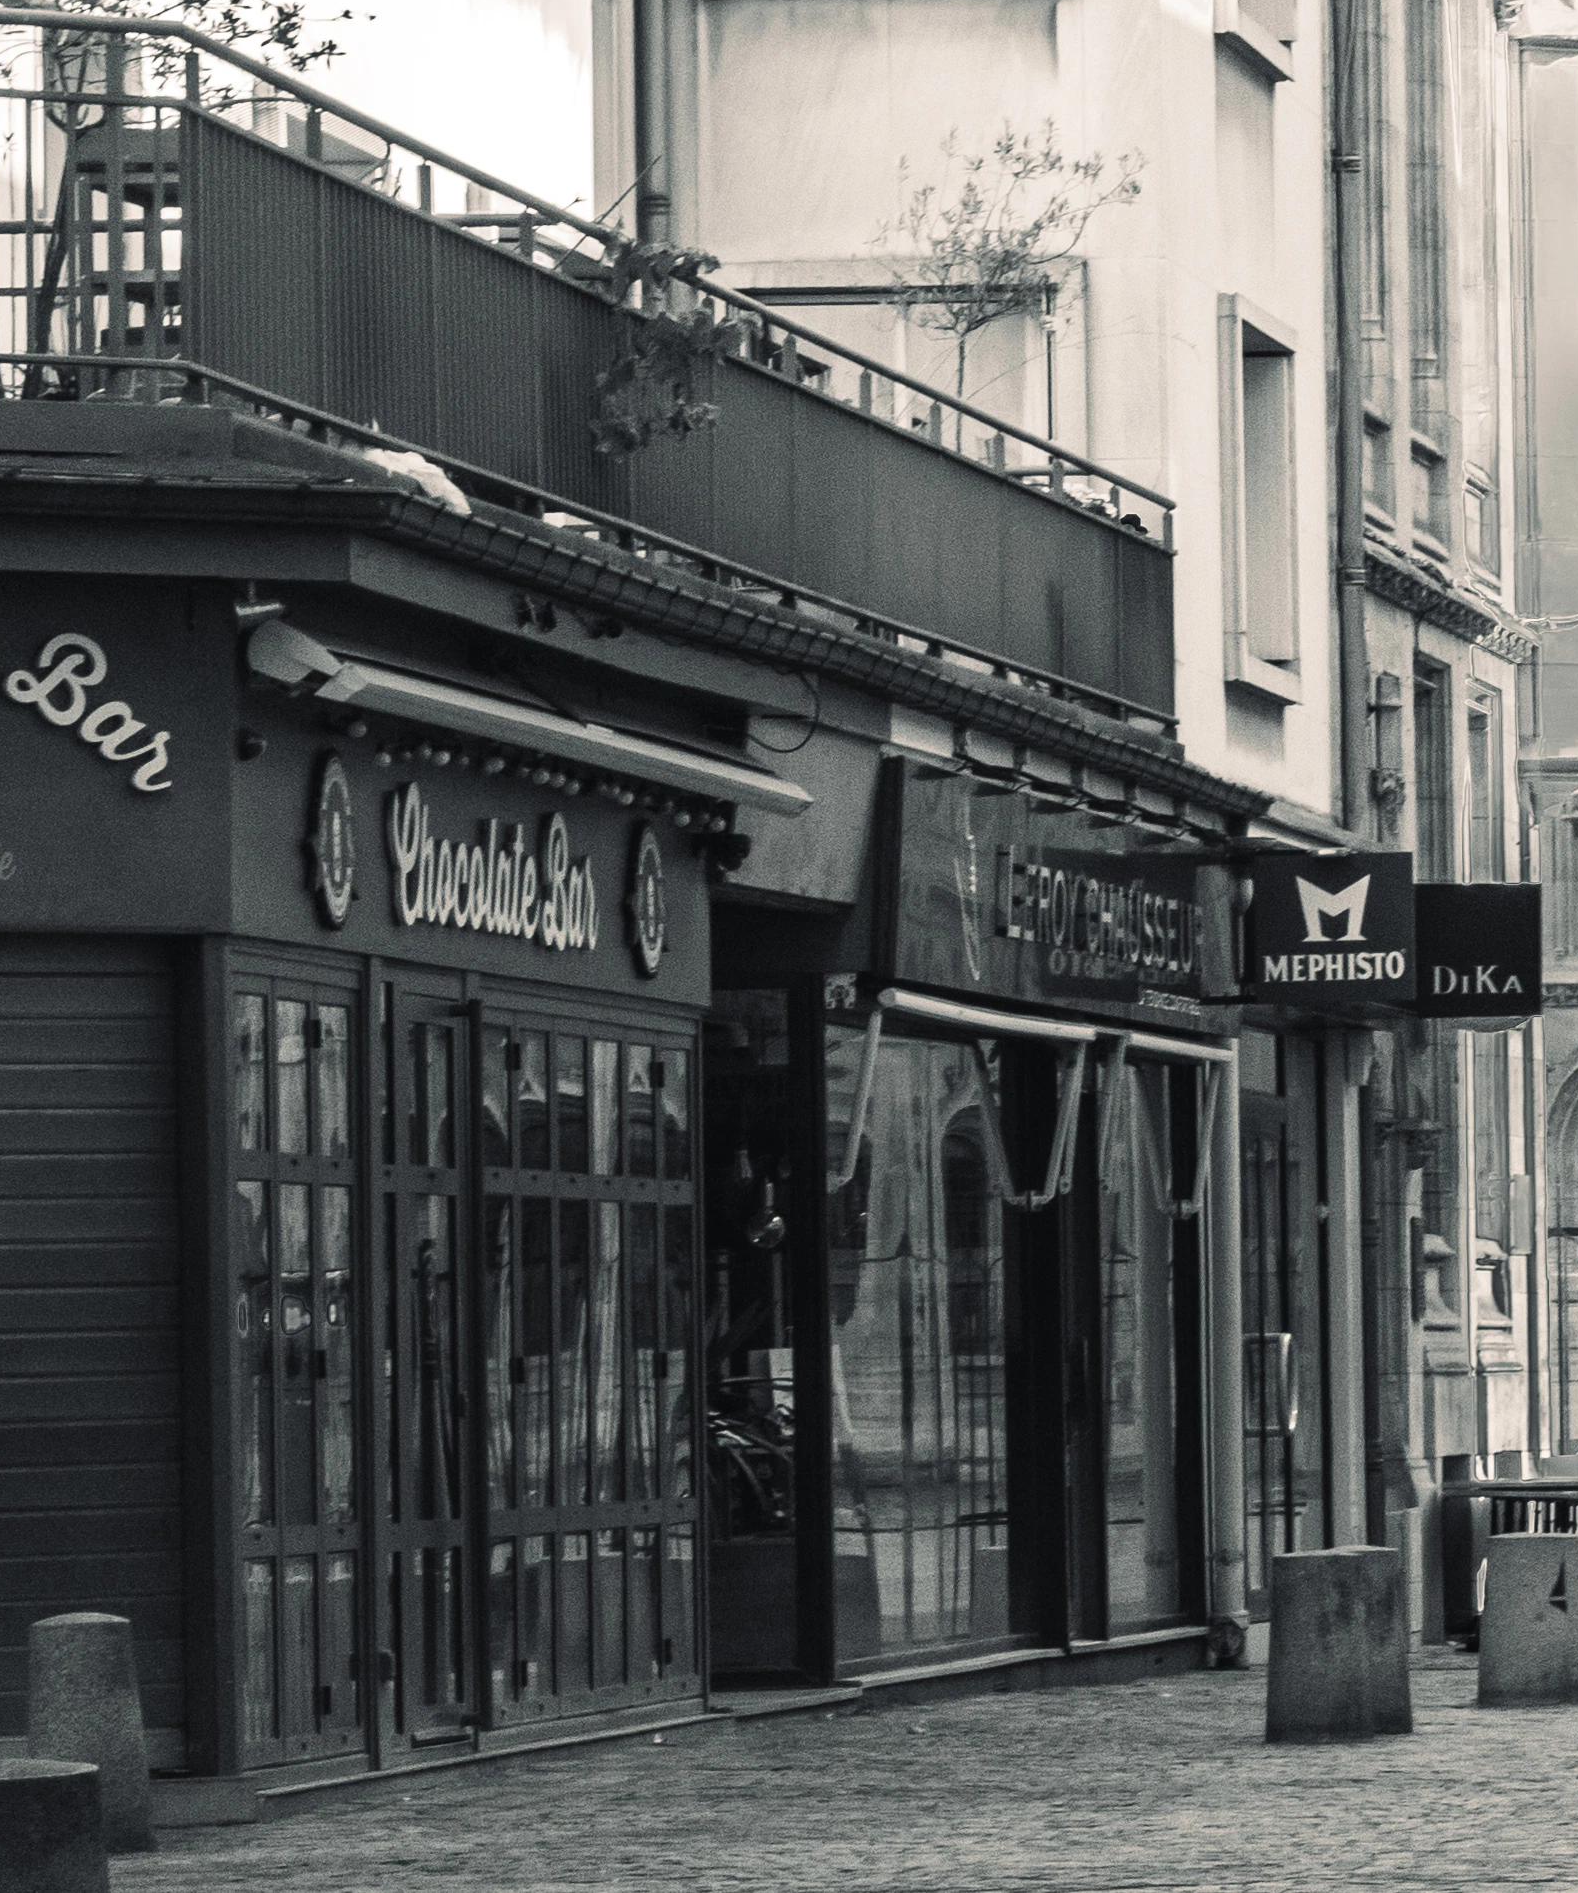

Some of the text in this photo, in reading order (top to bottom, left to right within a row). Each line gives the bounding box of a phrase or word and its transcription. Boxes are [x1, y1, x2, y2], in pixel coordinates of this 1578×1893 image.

[4, 633, 173, 792] Bar
[393, 781, 599, 951] Chocolate Bar
[1264, 951, 1406, 982] MEPHISTO
